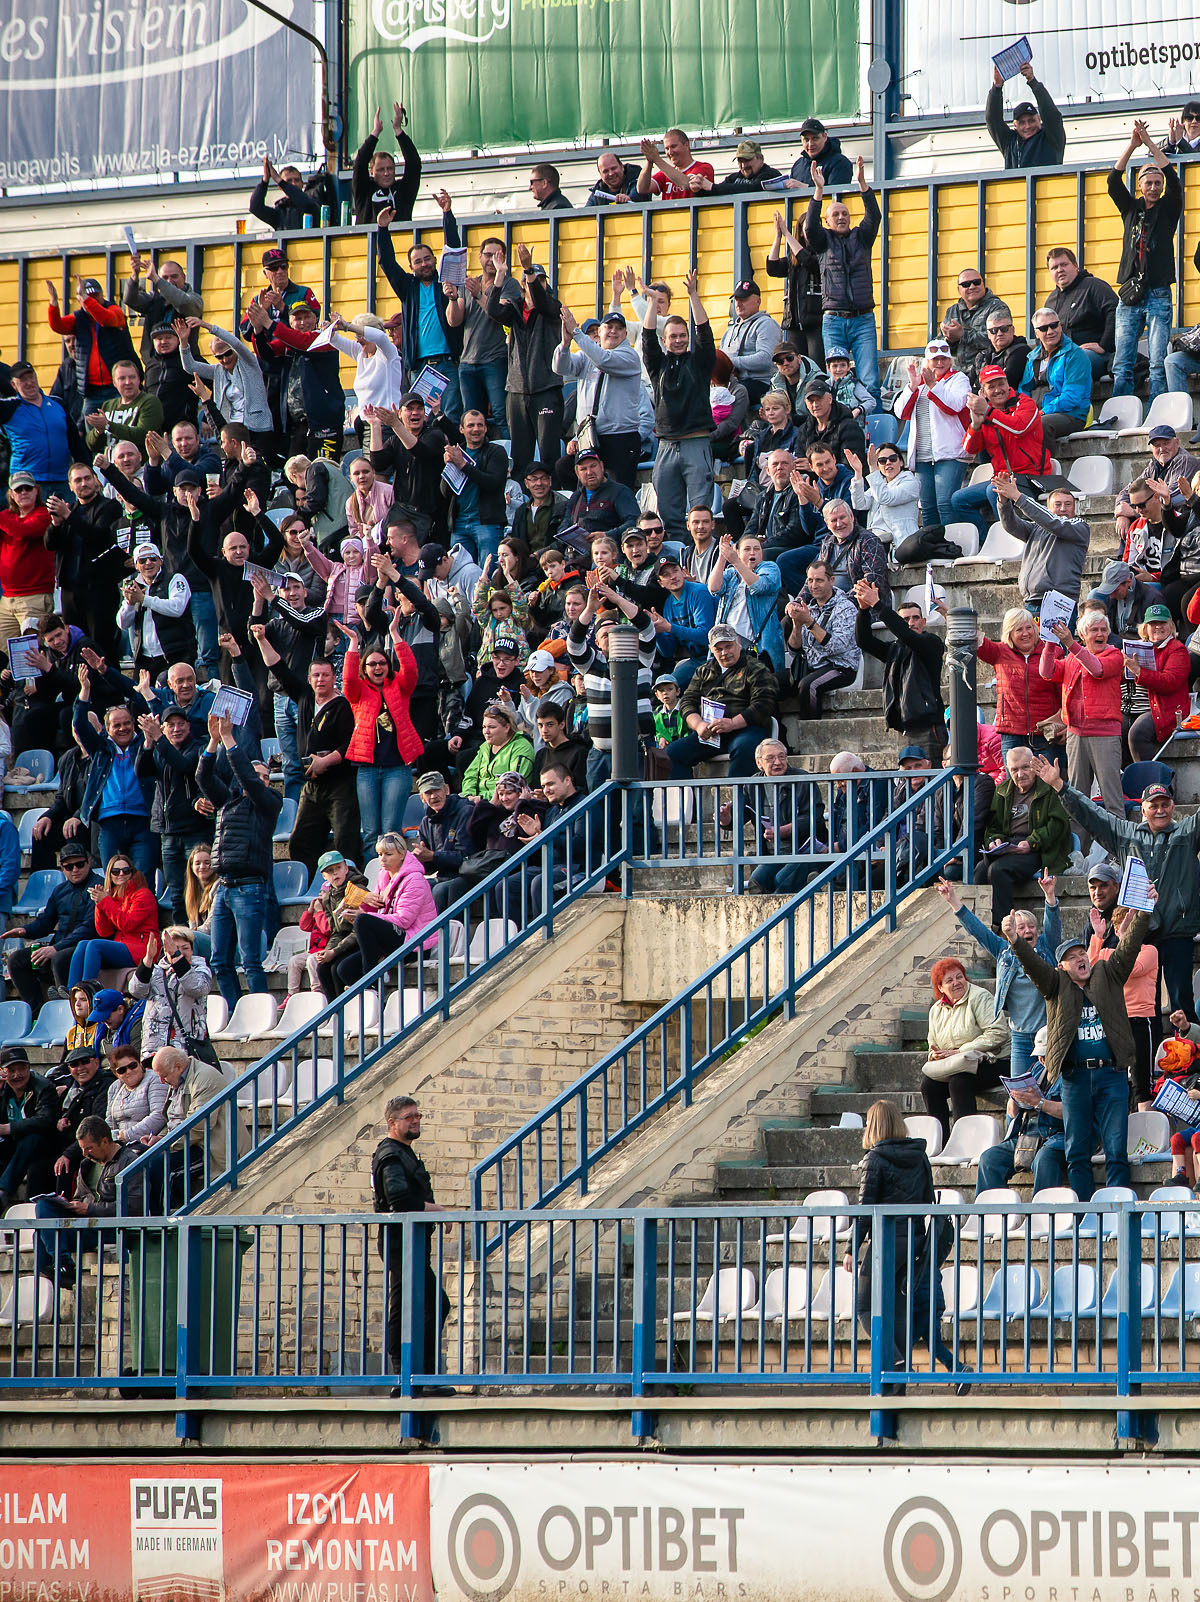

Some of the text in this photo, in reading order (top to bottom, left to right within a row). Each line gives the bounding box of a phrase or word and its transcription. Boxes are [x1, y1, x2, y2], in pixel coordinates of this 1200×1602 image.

[0, 0, 207, 62] es visiem
[92, 134, 289, 174] www.zila-ezerzeme.lv
[0, 1493, 67, 1524] ILAM
[136, 1486, 217, 1520] PUFAS
[287, 1493, 394, 1525] IZCILAM
[0, 1538, 90, 1570] ONTAM
[136, 1537, 218, 1552] MADE IN GERMANY
[537, 1504, 745, 1572] OPTIBET
[980, 1508, 1200, 1579] OPTIBET
[266, 1538, 418, 1571] REMONTAM
[539, 1577, 748, 1598] SPORTA BĀRS
[981, 1585, 1101, 1601] SPORTA
